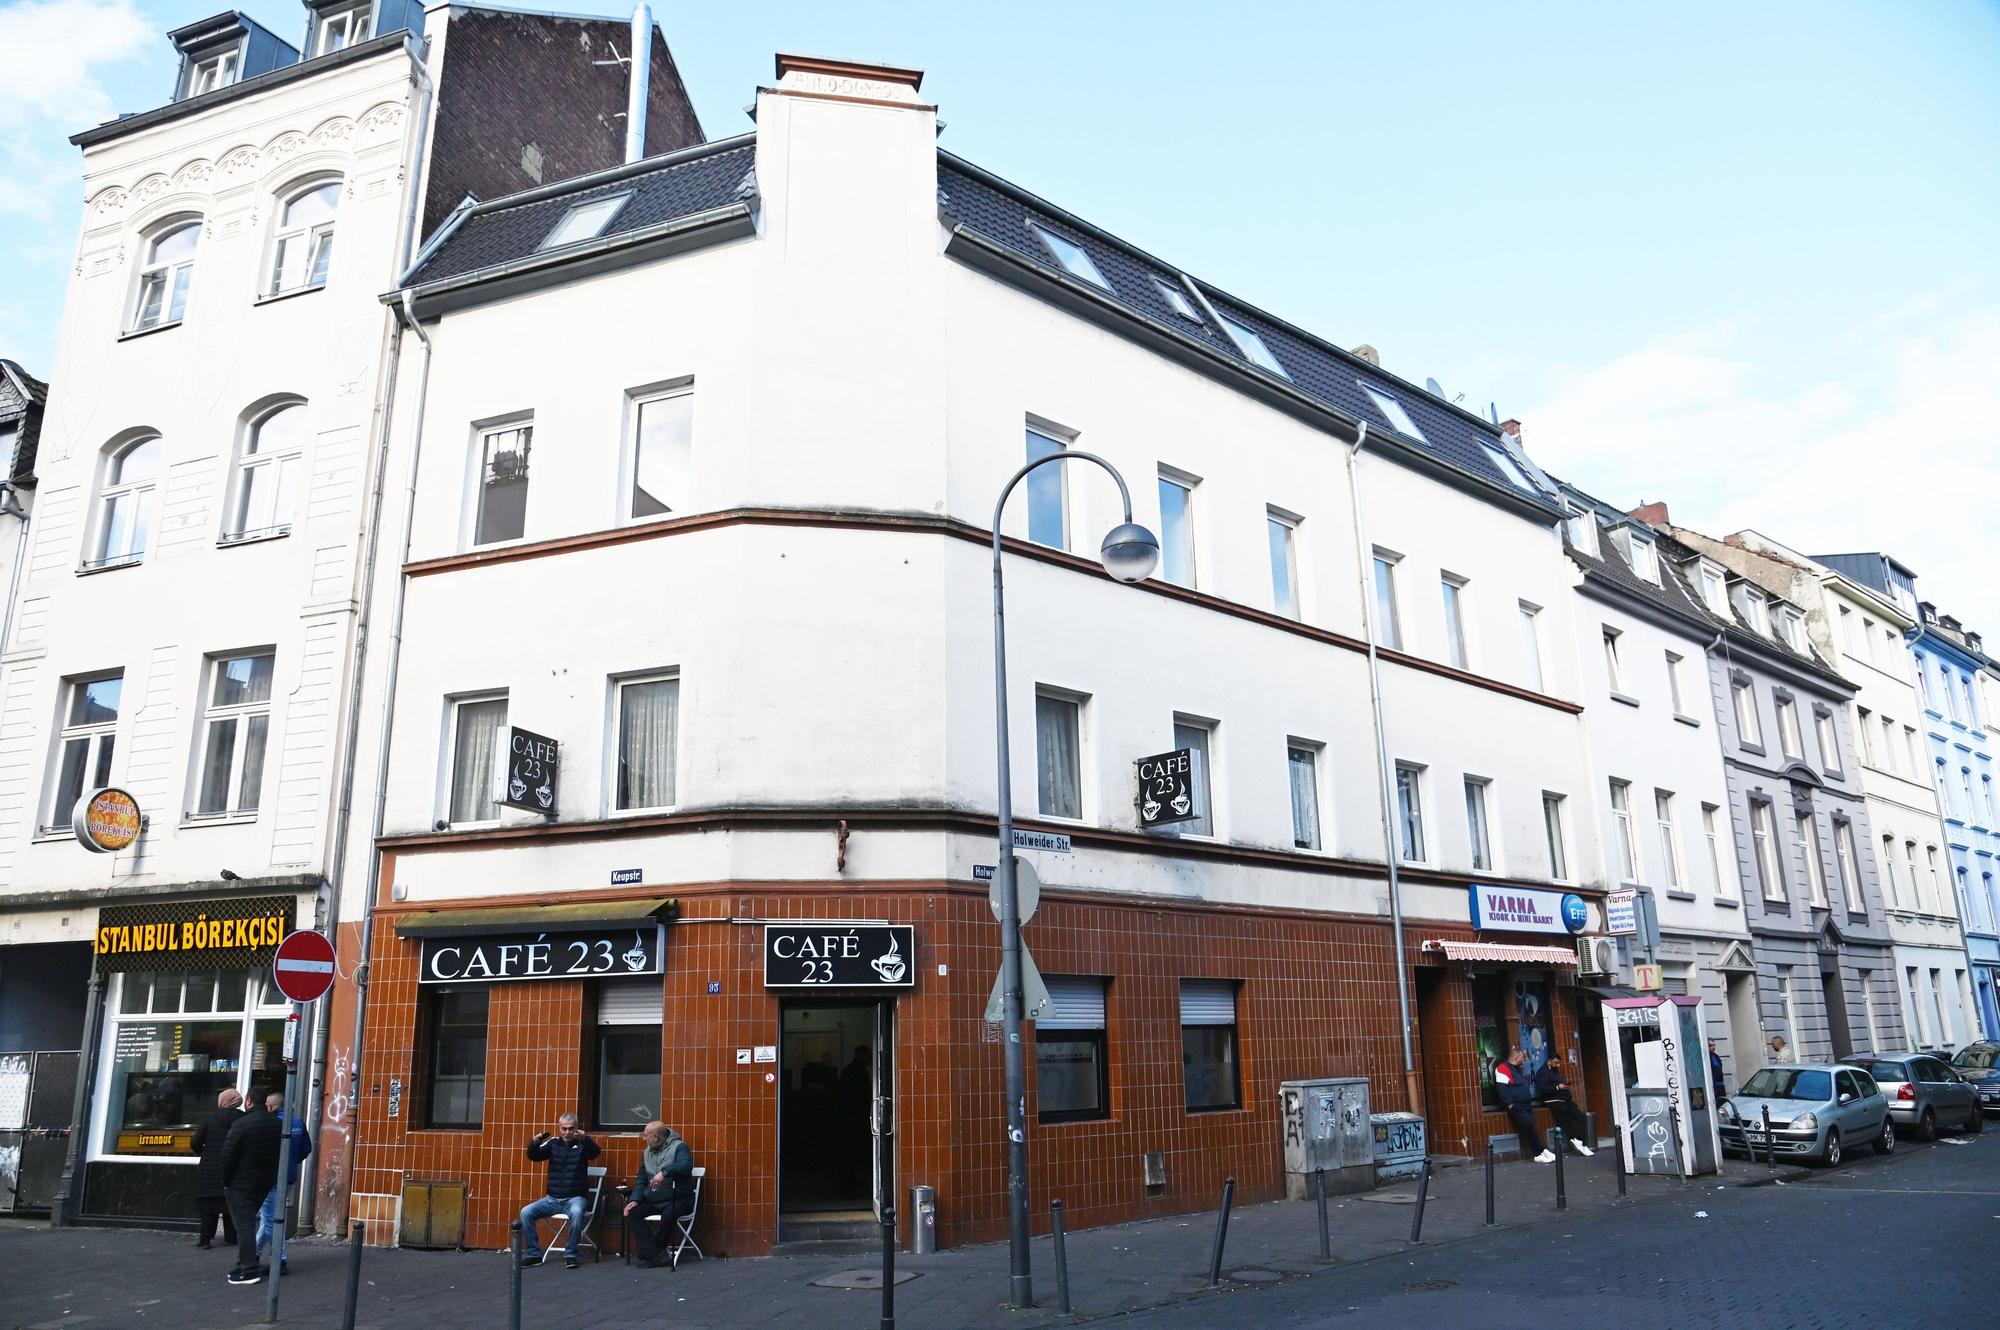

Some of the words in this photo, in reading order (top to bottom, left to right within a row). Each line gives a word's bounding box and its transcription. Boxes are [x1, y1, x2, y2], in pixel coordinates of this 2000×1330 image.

[512, 735, 556, 763] CAFÉ
[524, 758, 541, 779] 23
[1140, 751, 1189, 780] CAFÉ
[1156, 776, 1174, 795] 23
[1013, 831, 1054, 849] Holweider
[1056, 837, 1070, 850] Str.
[612, 870, 641, 883] Keupstr.
[1487, 894, 1536, 915] VARNA
[1608, 894, 1632, 904] Varna
[1488, 911, 1509, 922] KIOSK
[1511, 914, 1516, 923] &
[1517, 914, 1532, 924] MINI
[773, 929, 861, 959] CAFÉ
[430, 933, 553, 979] CAFÉ
[566, 940, 615, 974] 23
[801, 960, 834, 983] 23
